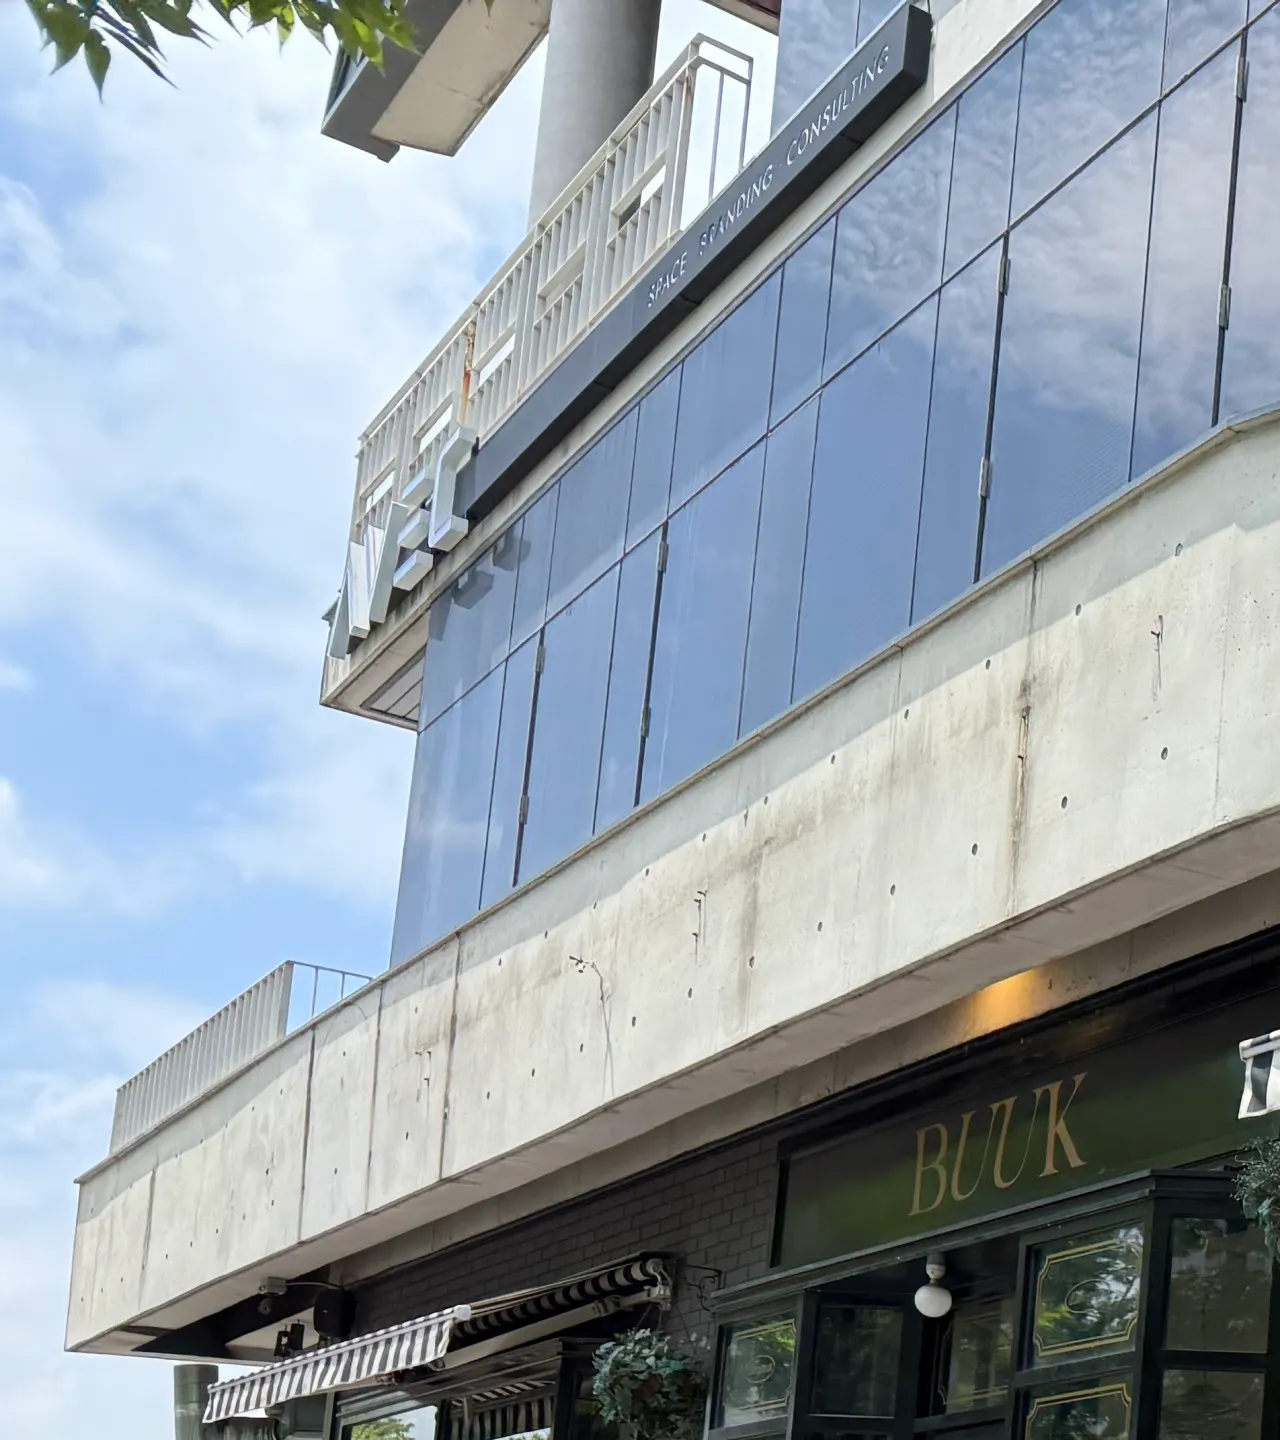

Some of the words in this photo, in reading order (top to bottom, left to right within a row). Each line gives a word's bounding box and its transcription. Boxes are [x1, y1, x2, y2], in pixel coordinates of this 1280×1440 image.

[647, 252, 688, 308] SPACE
[698, 164, 773, 256] BRANDING
[786, 44, 890, 167] CONSULTING
[908, 1071, 1089, 1218] BUUK
